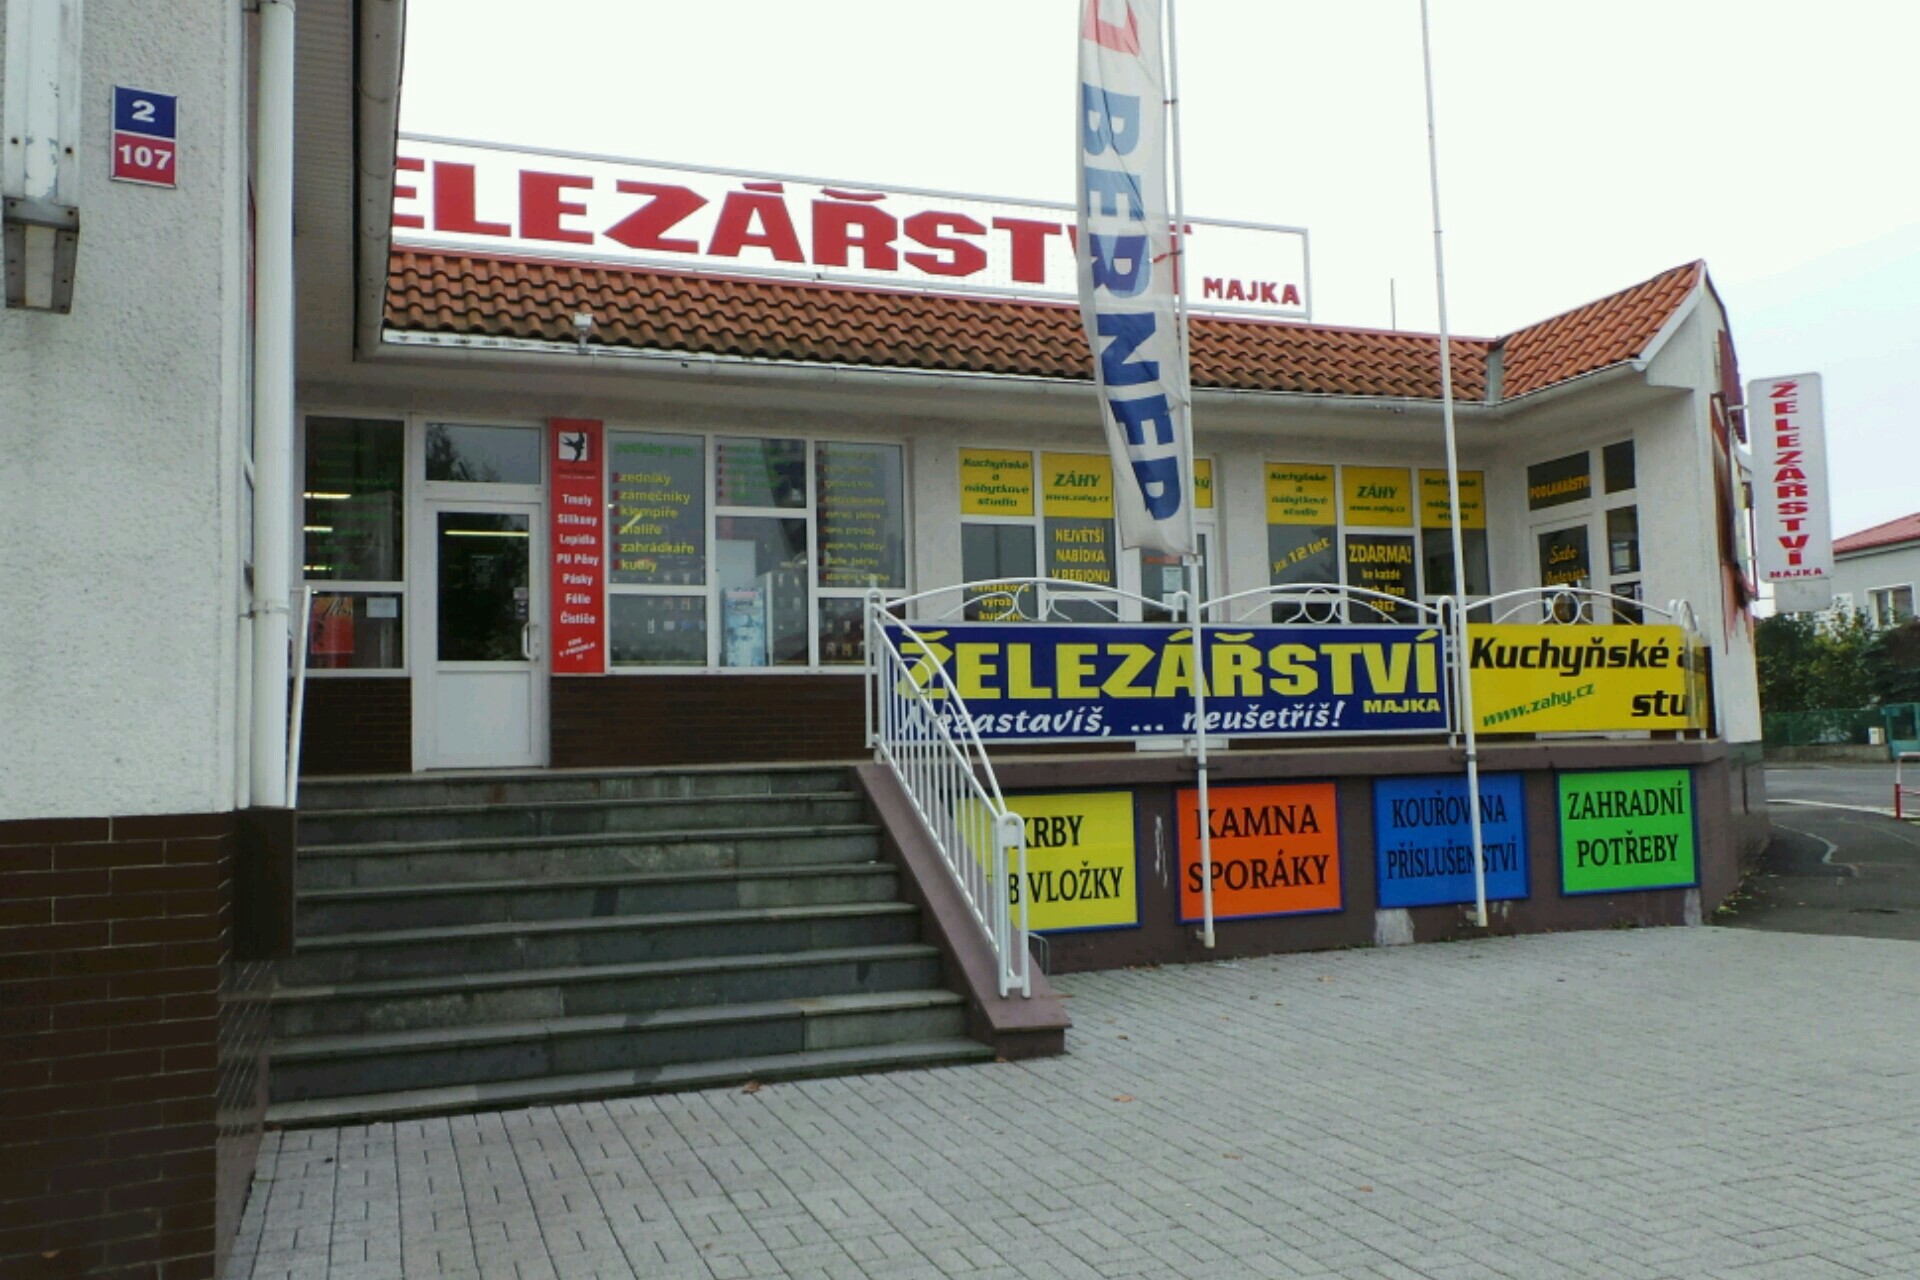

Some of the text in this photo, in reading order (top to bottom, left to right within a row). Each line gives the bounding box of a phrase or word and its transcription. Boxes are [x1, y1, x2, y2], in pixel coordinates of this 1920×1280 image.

[132, 99, 155, 122] 2
[118, 144, 172, 170] 107
[393, 157, 1192, 297] LEZÁŘSTV
[1203, 277, 1301, 306] MAJKA
[1053, 470, 1102, 487] ZÁHY
[1357, 483, 1397, 498] ZÁHY
[1055, 527, 1105, 543] NEJVĚTŠÍ
[1055, 546, 1106, 563] NABÍDKA
[1288, 546, 1307, 563] 12
[1349, 544, 1412, 564] ZDARMA!
[1061, 569, 1111, 583] REGIONU
[1770, 568, 1823, 579] MAJKA
[897, 629, 1438, 699] ŽELEZÁŘSTVÍ
[1470, 637, 1668, 677] Kuchyňské
[1182, 700, 1346, 731] neušetříš!
[1363, 698, 1440, 713] MAJKA
[1483, 684, 1595, 727] www.zahy.cz
[1567, 779, 1685, 820] ZAHRADNÍ
[1195, 803, 1321, 840] KAMNA
[1386, 835, 1518, 879] PŘÍSLUŠENSTVÍ
[1576, 830, 1679, 868] POTŘEBY
[1026, 861, 1123, 903] VLOŽKY
[1188, 849, 1330, 893] SPORÁKY
